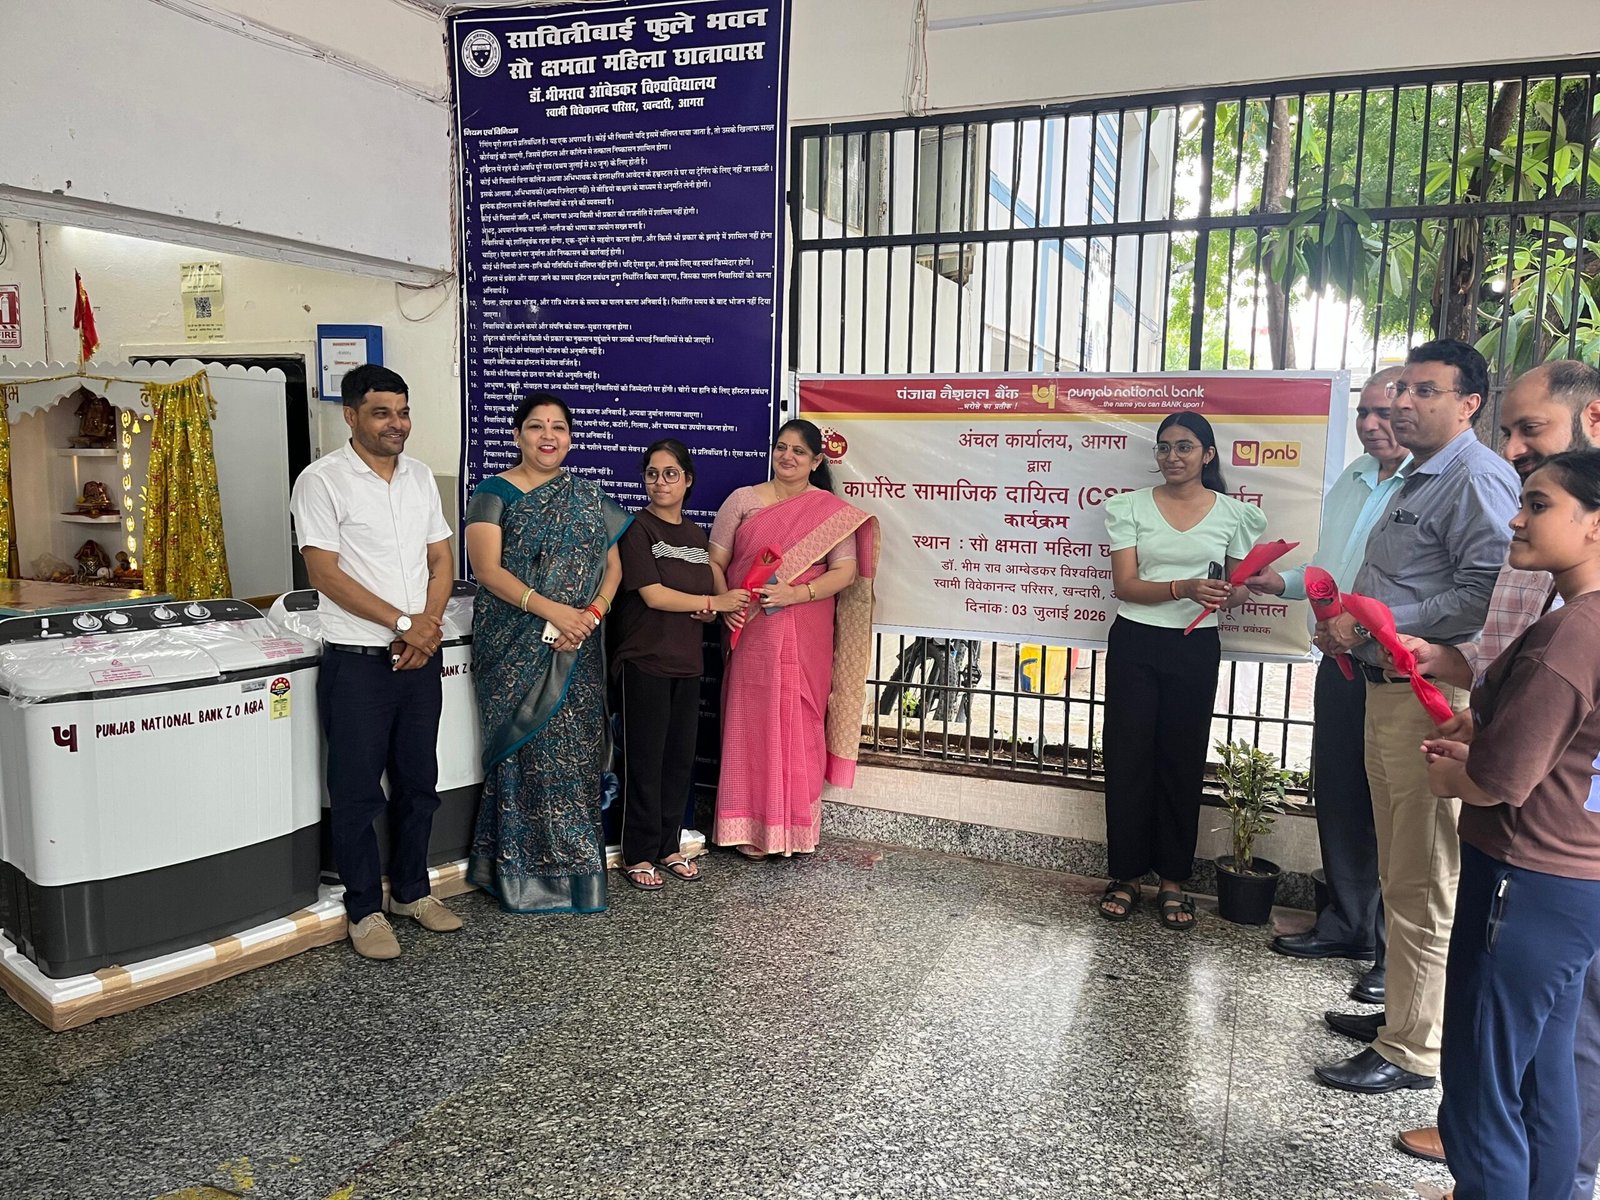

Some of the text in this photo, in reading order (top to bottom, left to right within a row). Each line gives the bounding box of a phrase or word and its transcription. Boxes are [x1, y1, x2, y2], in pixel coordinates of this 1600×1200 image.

[644, 11, 695, 41] फुले
[706, 8, 768, 30] भवन
[507, 41, 765, 79] सौ क्षमता महिला छात्रावास
[589, 81, 637, 98] आंबेडकर
[640, 76, 716, 94] विश्वविद्यालय
[545, 97, 704, 116] स्वामी विवेकानन्द परिसर, खन्दारी, आगरा
[896, 384, 1019, 401] पंजाब नैशनल बैंक
[1067, 385, 1204, 400] punjab national bank
[958, 429, 1128, 452] अंचल कार्यालय, आगरा
[1262, 444, 1298, 464] pnb
[1027, 460, 1052, 472] द्वारा
[843, 476, 906, 499] कार्पोरेट
[912, 479, 998, 502] सामाजिक
[1004, 480, 1070, 504] दायित्व
[1004, 510, 1070, 529] कार्यक्रम
[912, 535, 950, 550] स्थान
[969, 534, 988, 552] सौ
[995, 538, 1038, 555] क्षमता
[1044, 537, 1093, 557] महिला
[941, 558, 957, 571] डॉ.
[962, 558, 980, 572] भीम
[985, 564, 1001, 573] राव
[1005, 562, 1056, 577] आम्बेडकर
[933, 577, 961, 589] स्वामी
[965, 578, 1016, 593] विवेकानन्द
[1021, 581, 1058, 596] परिसर,
[1063, 584, 1105, 600] खन्दारी,
[1012, 604, 1027, 615] 03
[1033, 605, 1070, 622] जुलाई
[1074, 609, 1106, 622] 2026
[1243, 623, 1271, 634] प्रबंधक
[442, 665, 459, 678] BANK
[462, 663, 467, 674] Z
[96, 720, 136, 739] PUNJAB
[141, 713, 195, 731] NATIONAL
[199, 707, 223, 723] BANK
[226, 706, 232, 718] Z
[244, 699, 264, 715] AGRA
